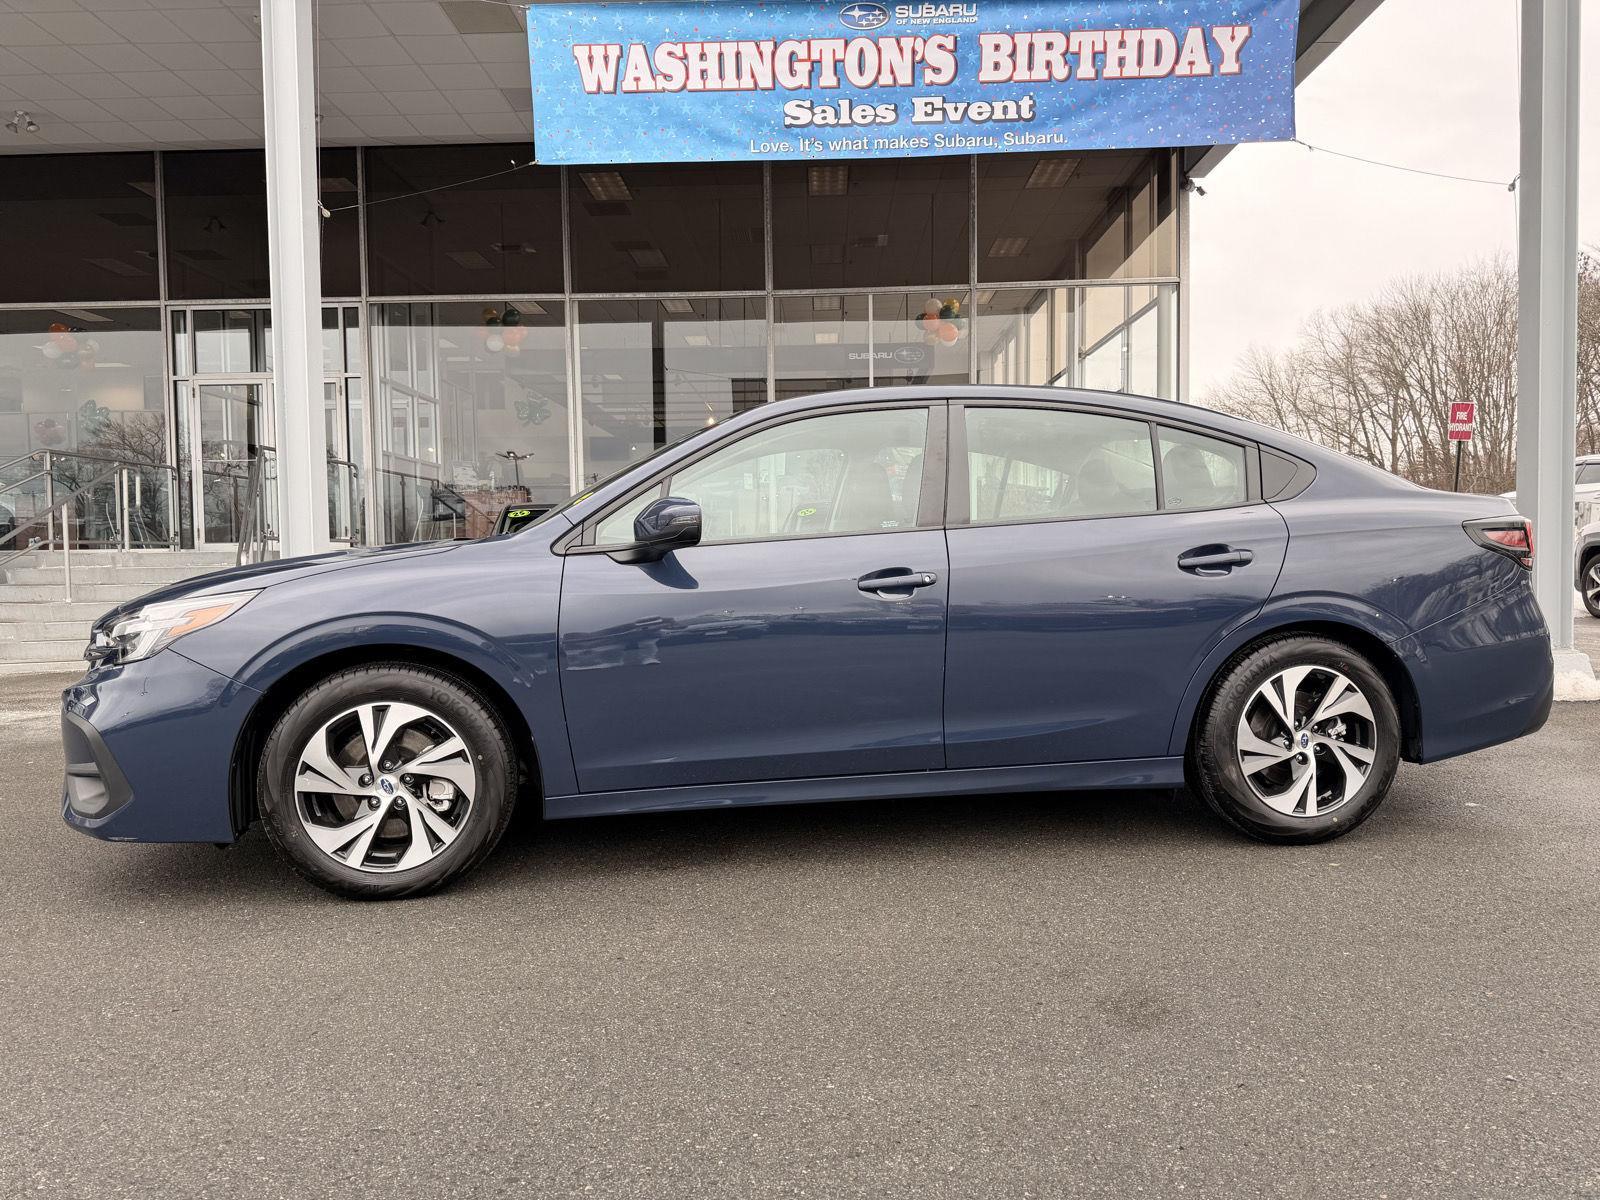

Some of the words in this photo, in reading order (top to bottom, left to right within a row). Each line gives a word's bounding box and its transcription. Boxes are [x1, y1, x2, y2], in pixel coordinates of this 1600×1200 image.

[895, 3, 977, 18] SUBARU
[934, 16, 977, 24] ENGLAND
[573, 35, 957, 95] WASHINGTON'S
[978, 26, 1251, 84] BIRTHDAY
[784, 98, 899, 128] Sales
[911, 94, 1036, 124] Event
[750, 138, 794, 154] Love.
[799, 136, 823, 152] It's
[828, 136, 868, 151] what
[874, 134, 929, 150] makes
[934, 133, 998, 149] Subaru,
[1003, 131, 1068, 146] Subaru.
[1456, 411, 1468, 420] FIRE
[1448, 422, 1473, 432] HYDRANT
